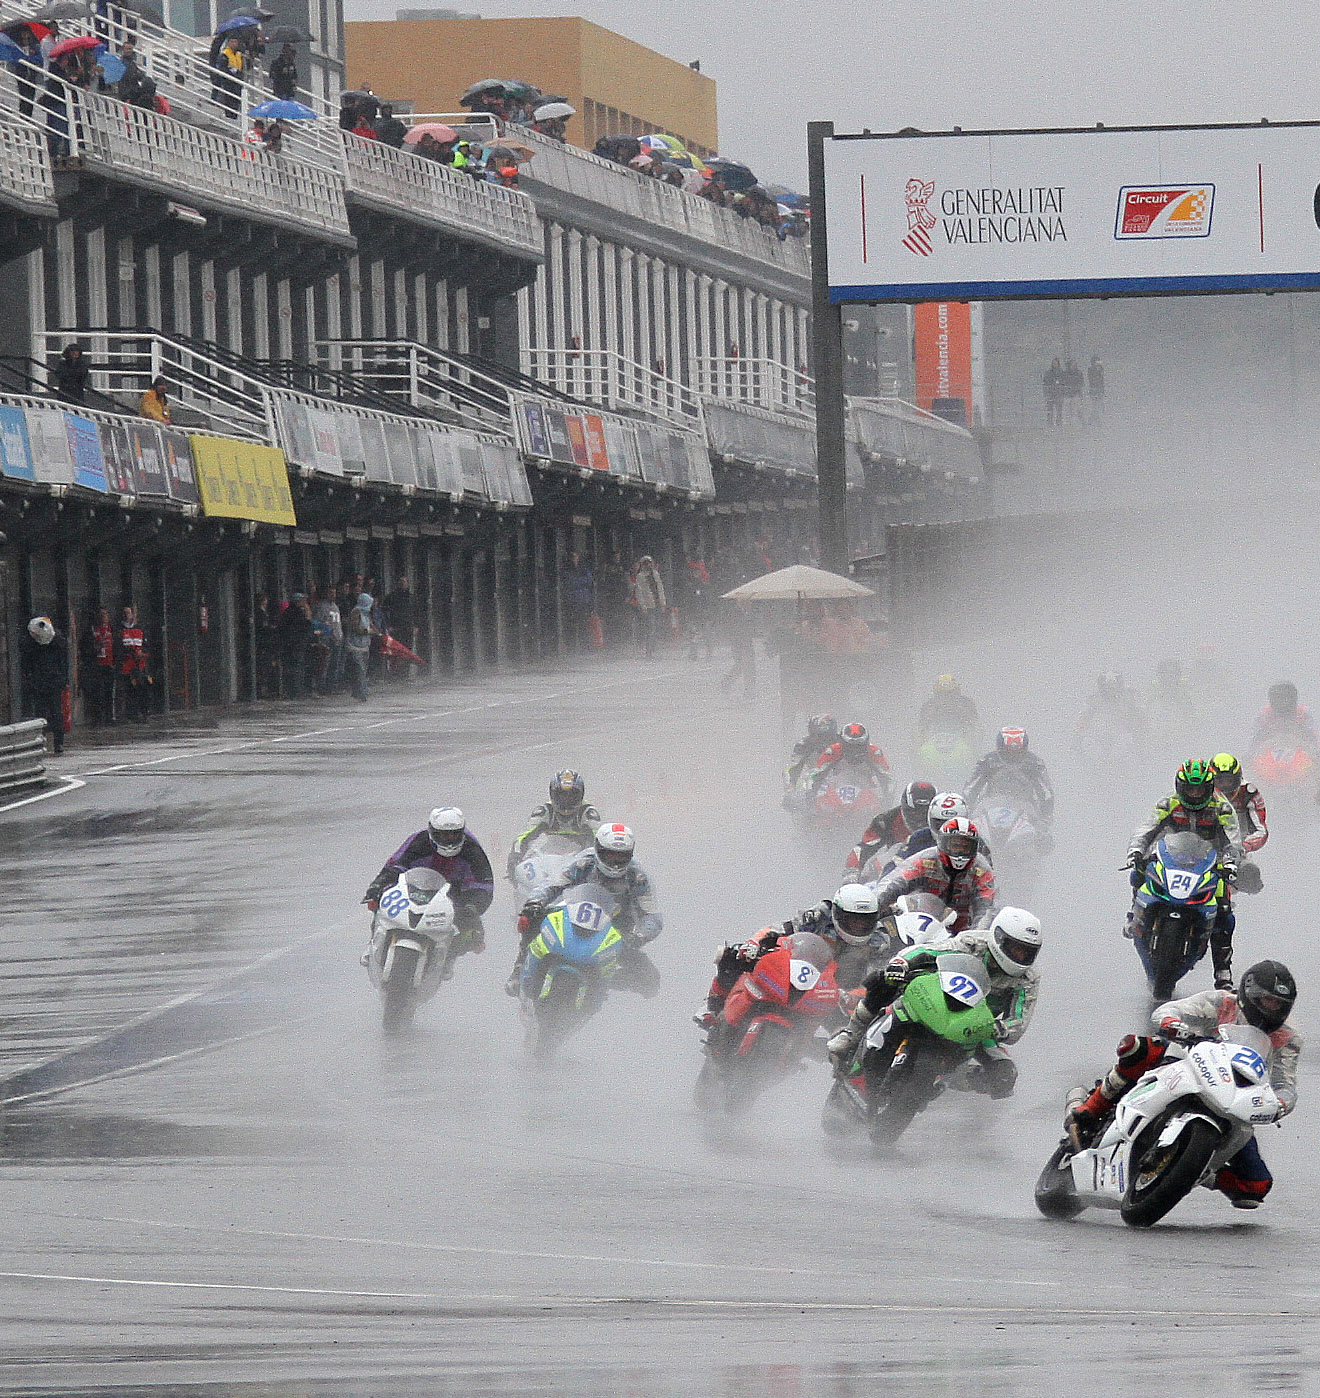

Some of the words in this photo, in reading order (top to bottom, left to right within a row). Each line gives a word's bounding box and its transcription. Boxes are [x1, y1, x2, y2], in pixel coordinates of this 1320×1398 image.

[941, 186, 1066, 216] GENERALITAT
[1128, 193, 1169, 204] Circuit
[942, 216, 1068, 244] VALENCIANA
[941, 796, 958, 809] 5
[1170, 874, 1192, 891] 24
[381, 889, 410, 919] 88
[576, 902, 603, 931] 61
[917, 914, 934, 932] 7
[797, 966, 811, 984] 8
[948, 975, 979, 999] 97
[1231, 1047, 1267, 1079] 26
